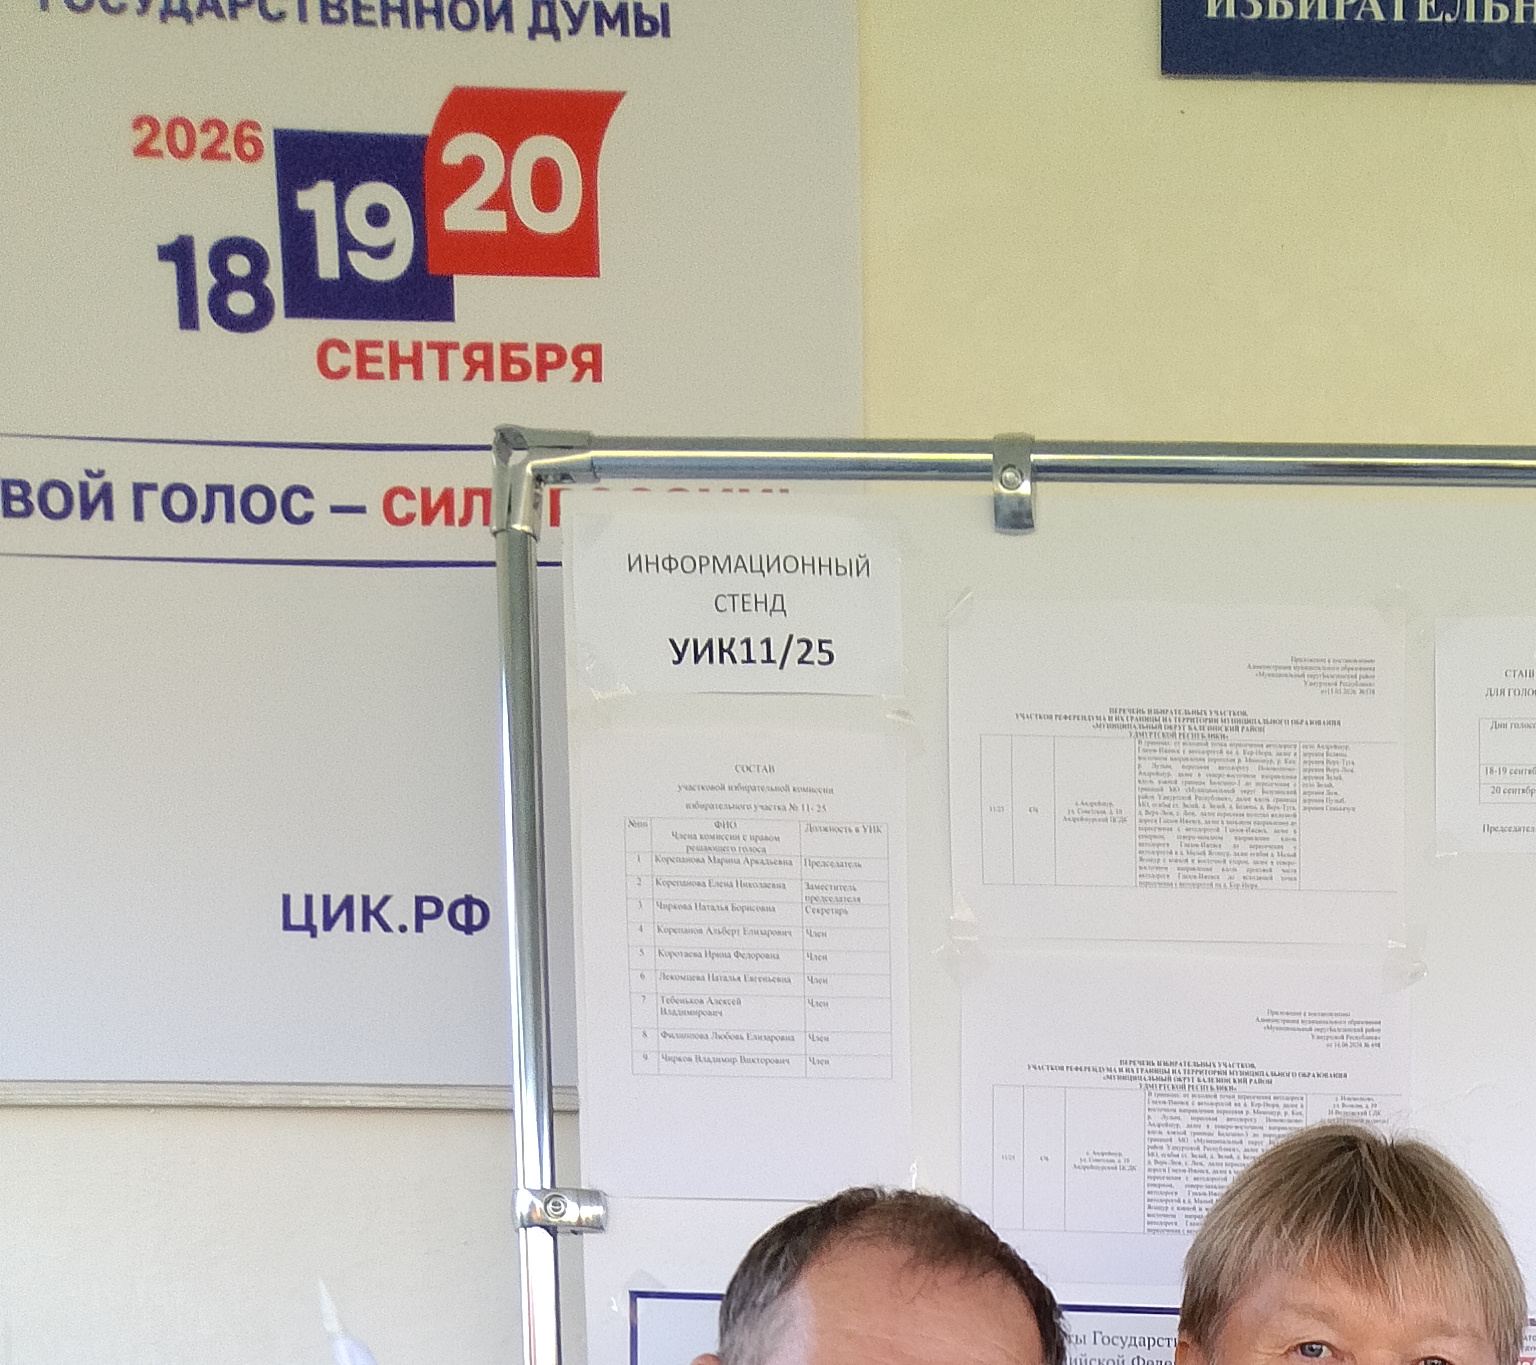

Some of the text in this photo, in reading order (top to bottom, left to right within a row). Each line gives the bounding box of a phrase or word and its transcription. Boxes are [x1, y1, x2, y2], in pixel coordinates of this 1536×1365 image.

[527, 0, 671, 42] ДУМЫ
[133, 115, 264, 164] 2026
[156, 132, 583, 333] 18 19 20
[316, 338, 603, 383] СЕНТЯБРЯ
[132, 483, 316, 527] ГОЛОС
[383, 485, 491, 527] СИЛ
[628, 553, 870, 578] ИНФОРМАЦИОННЫЙ
[714, 593, 787, 617] СТЕНД
[669, 634, 835, 670] УИК11/25
[1485, 688, 1505, 697] ДЛЯ
[735, 765, 775, 773] СОСТАВ
[1485, 767, 1507, 775] 18-19
[281, 893, 490, 938] ЦИК.РФ
[1093, 1331, 1177, 1350] Государст
